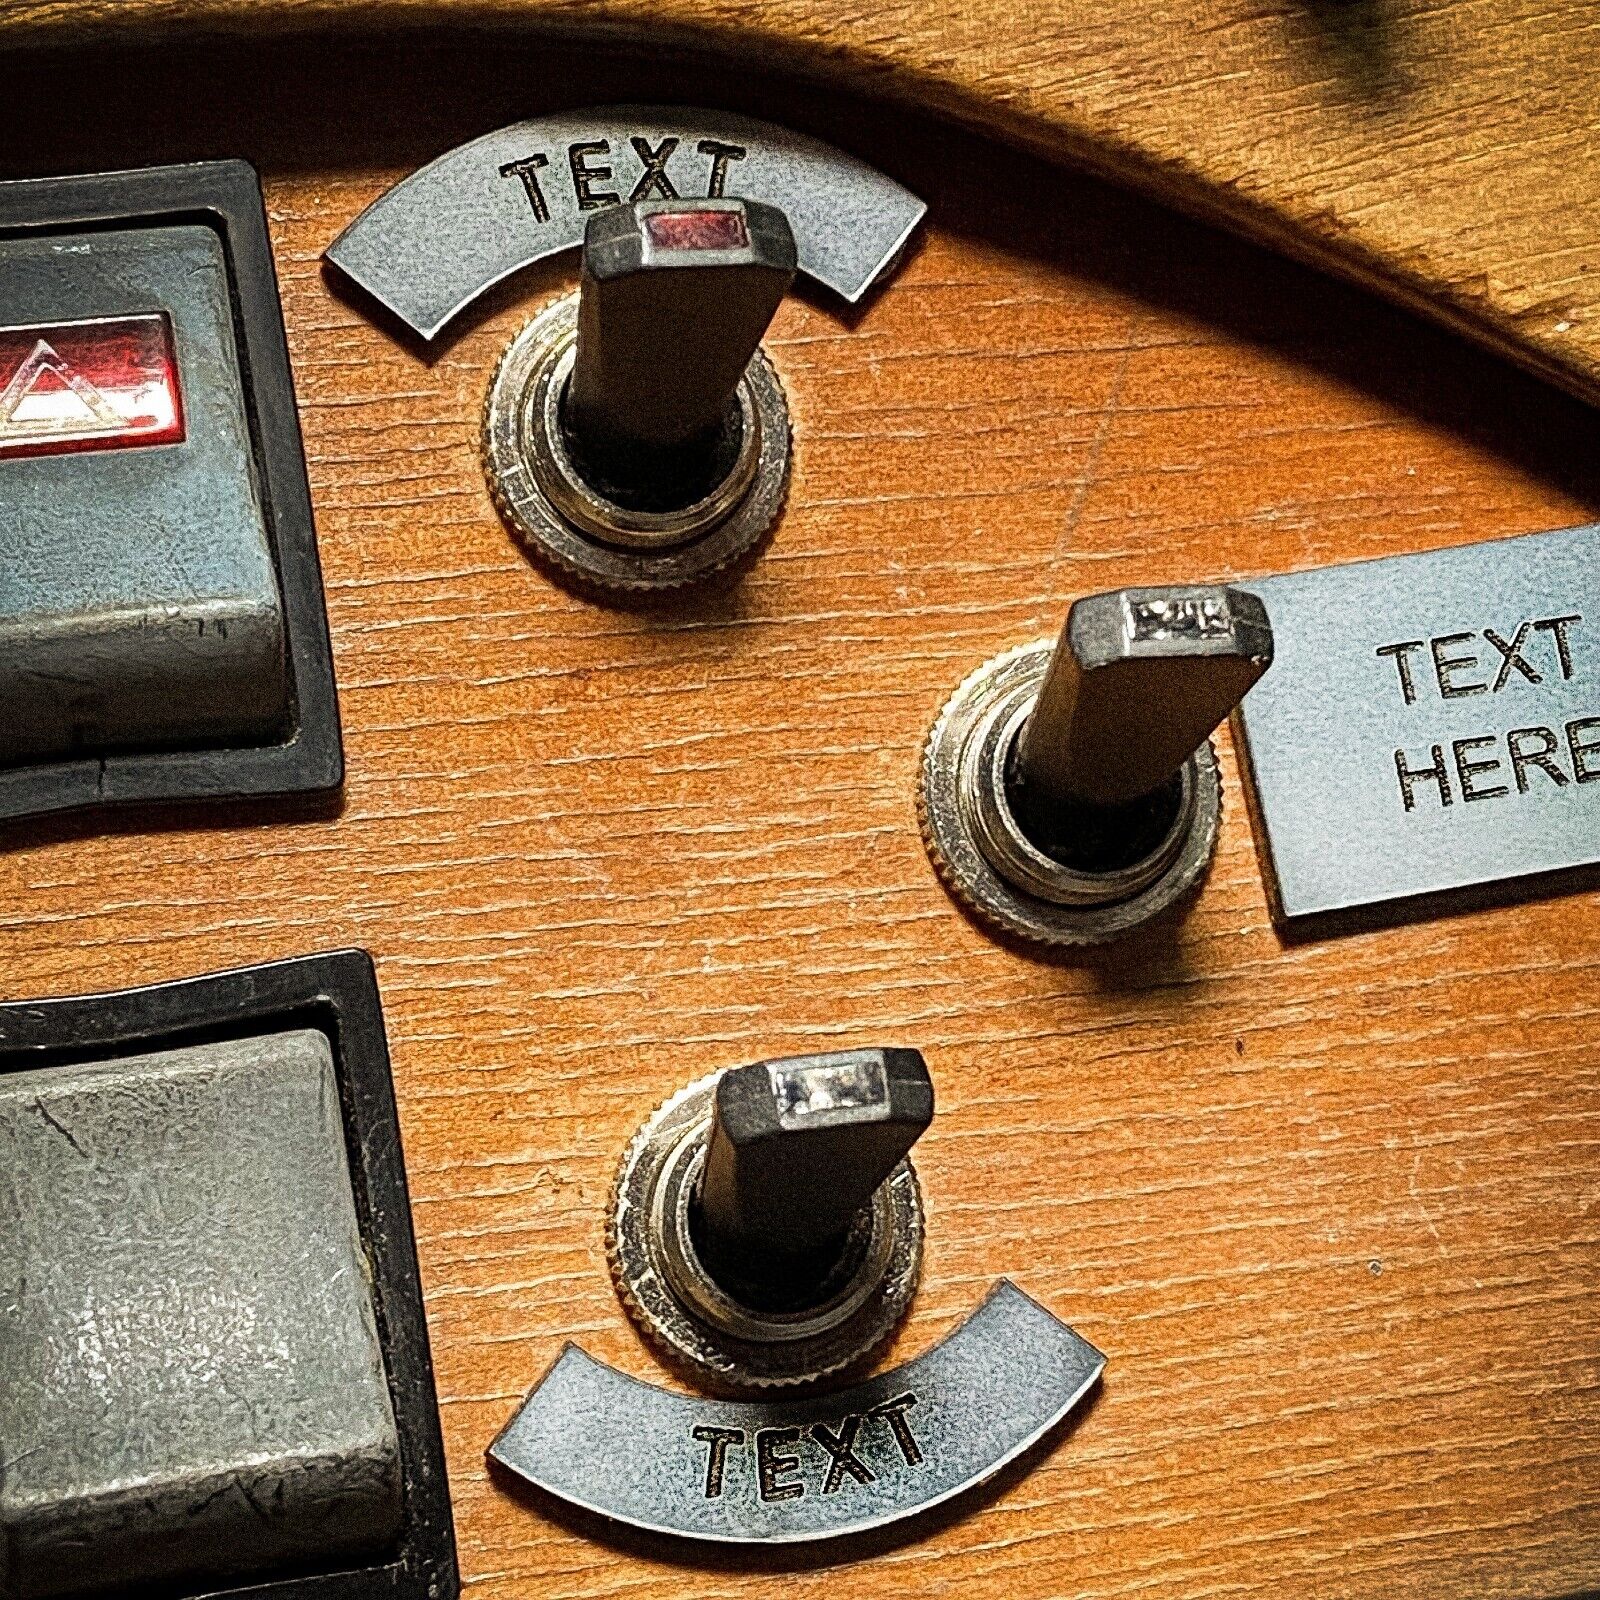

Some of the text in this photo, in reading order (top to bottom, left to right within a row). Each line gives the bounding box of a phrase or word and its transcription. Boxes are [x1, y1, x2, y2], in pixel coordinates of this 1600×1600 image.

[498, 137, 747, 223] TEXT
[1376, 614, 1582, 705] TEXT
[1394, 716, 1600, 812] HERE
[692, 1392, 924, 1502] TEXT
